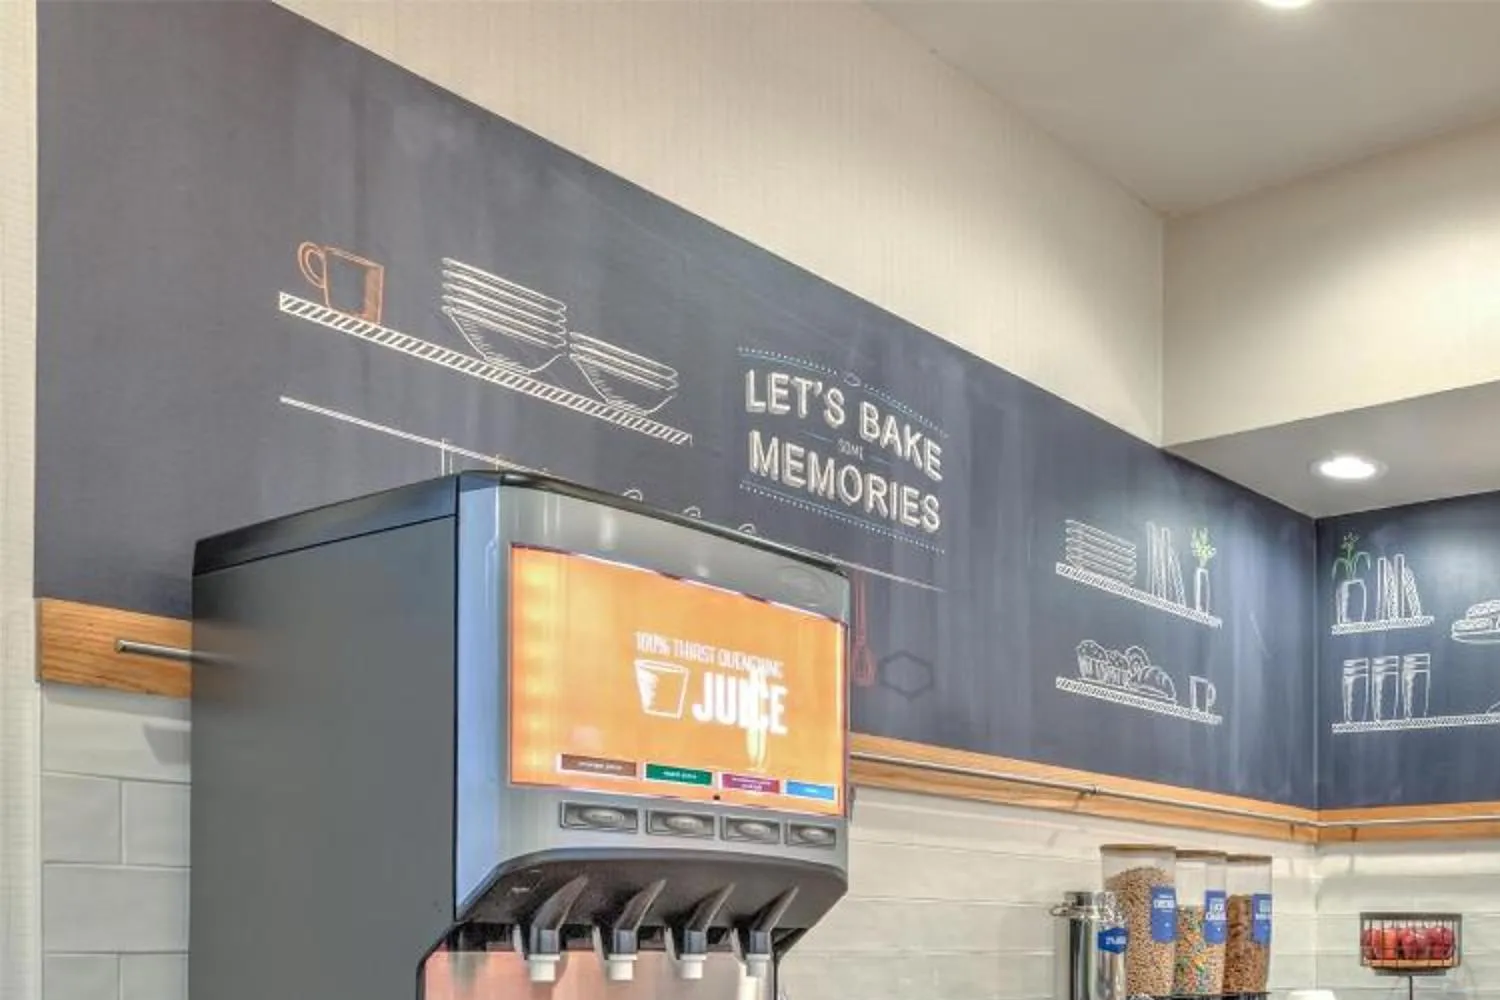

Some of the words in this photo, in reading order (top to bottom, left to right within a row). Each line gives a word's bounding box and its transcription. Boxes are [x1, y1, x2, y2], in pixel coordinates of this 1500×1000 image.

[745, 369, 846, 429] LET'S
[859, 401, 943, 481] BAKE
[749, 430, 941, 533] MEMORIES
[674, 639, 715, 664] THIRST
[692, 671, 788, 735] JUICE
